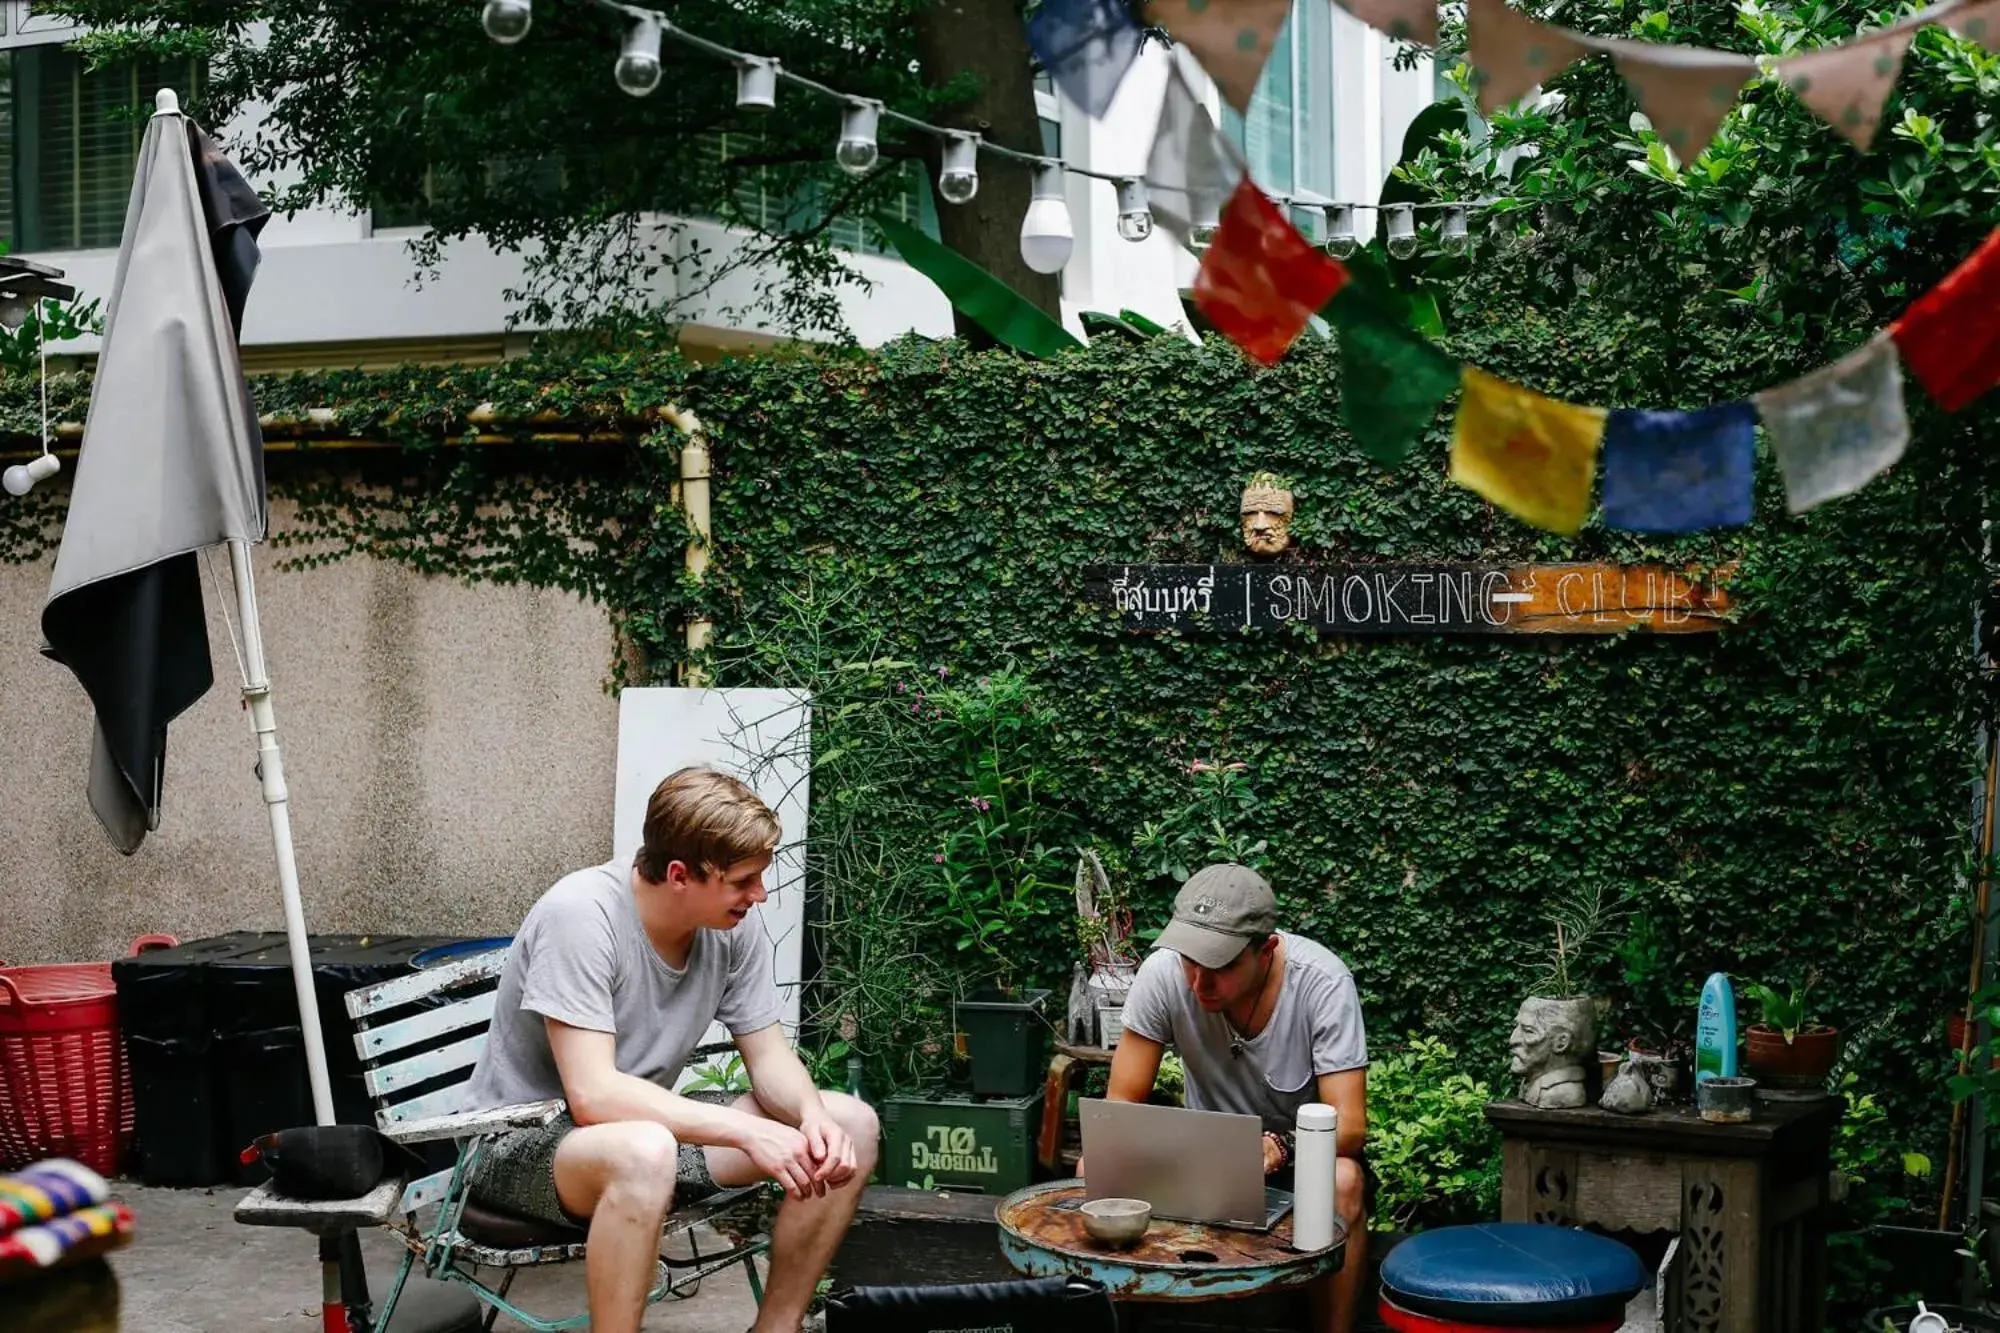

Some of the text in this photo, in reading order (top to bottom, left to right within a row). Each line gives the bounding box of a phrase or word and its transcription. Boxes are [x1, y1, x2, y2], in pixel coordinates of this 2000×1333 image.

[1112, 565, 1214, 623] ที่สูบบุหรี่
[1270, 571, 1693, 626] SMOKING CLUB
[911, 1142, 998, 1173] TUBORG
